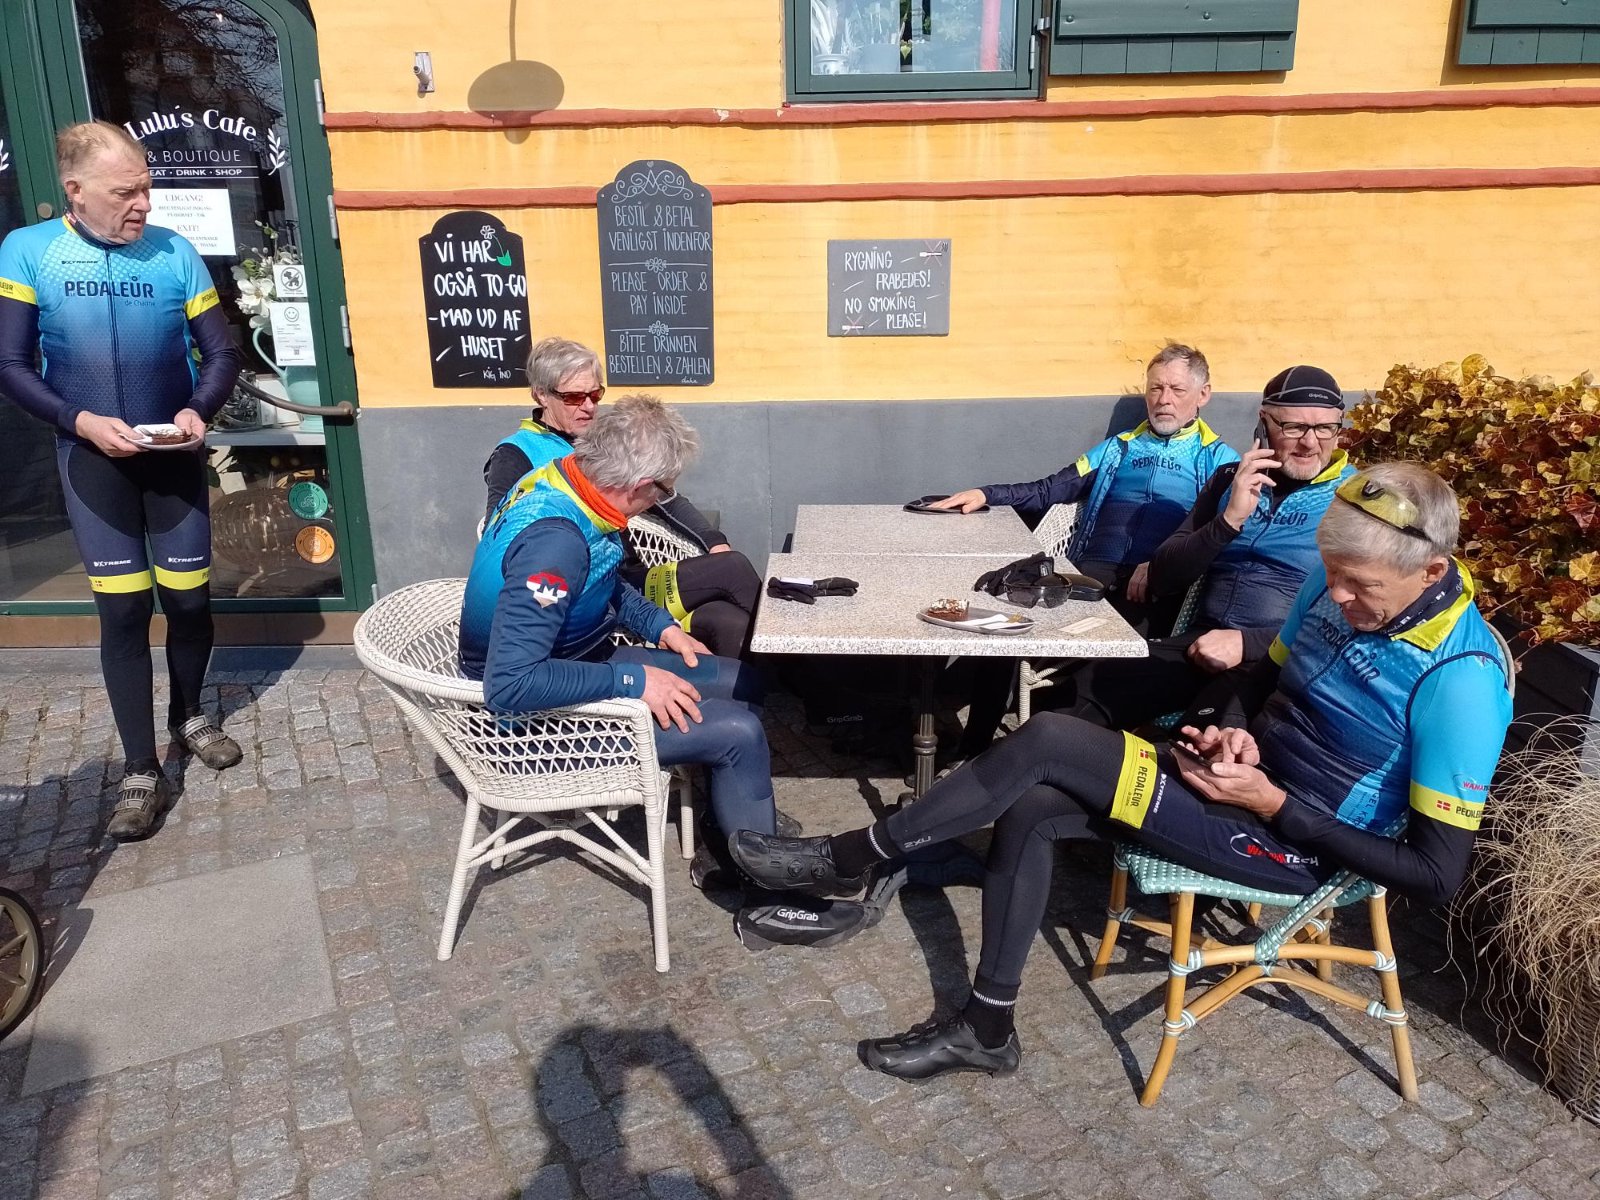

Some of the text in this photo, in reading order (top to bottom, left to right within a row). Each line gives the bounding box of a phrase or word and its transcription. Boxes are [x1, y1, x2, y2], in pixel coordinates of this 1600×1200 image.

[203, 109, 257, 141] Cafe
[163, 150, 242, 162] BOUTIQUE
[150, 169, 167, 177] EAT
[653, 204, 663, 227] &
[665, 204, 700, 228] BETAL
[461, 240, 497, 263] HAR
[844, 246, 893, 272] RYGNING
[64, 278, 155, 299] PEDALEUR
[434, 267, 478, 297] OGSÅ
[611, 271, 708, 292] PLEASE ORDER &
[629, 291, 688, 315] PAY INSIDE
[844, 291, 917, 315] NO SMOKING
[476, 308, 497, 328] UD
[503, 309, 522, 331] AF
[886, 311, 926, 329] PLEASE!
[460, 335, 507, 361] HUSET
[619, 331, 698, 353] BITTE DRINNEN
[608, 354, 661, 374] BESTELLEN
[665, 355, 674, 375] &
[1130, 765, 1149, 807] PEDALEUR
[777, 908, 819, 922] GripGrab
